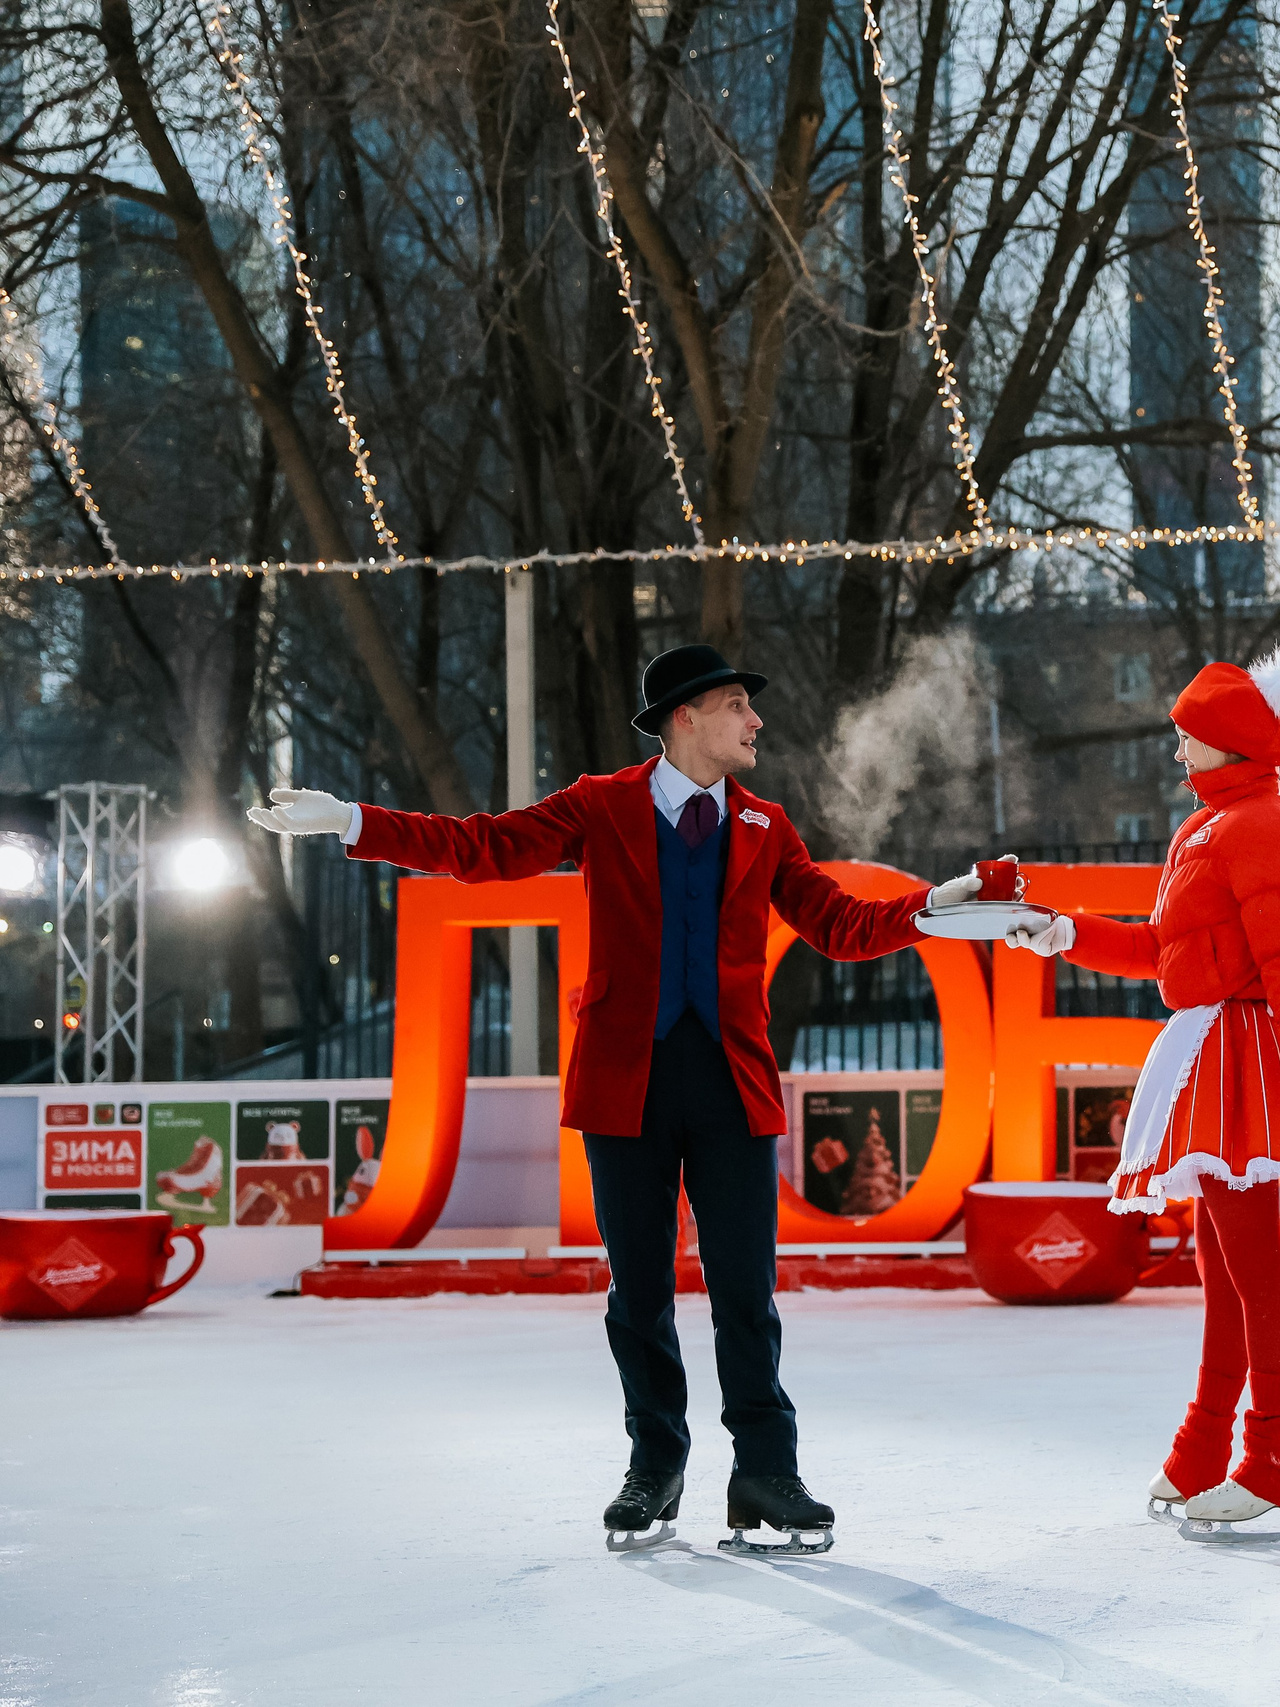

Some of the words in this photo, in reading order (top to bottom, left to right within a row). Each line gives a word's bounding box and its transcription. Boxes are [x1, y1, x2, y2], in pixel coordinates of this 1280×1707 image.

[52, 1140, 135, 1162] ЗИМА
[51, 1164, 63, 1177] В
[67, 1162, 135, 1176] МОСКВЕ
